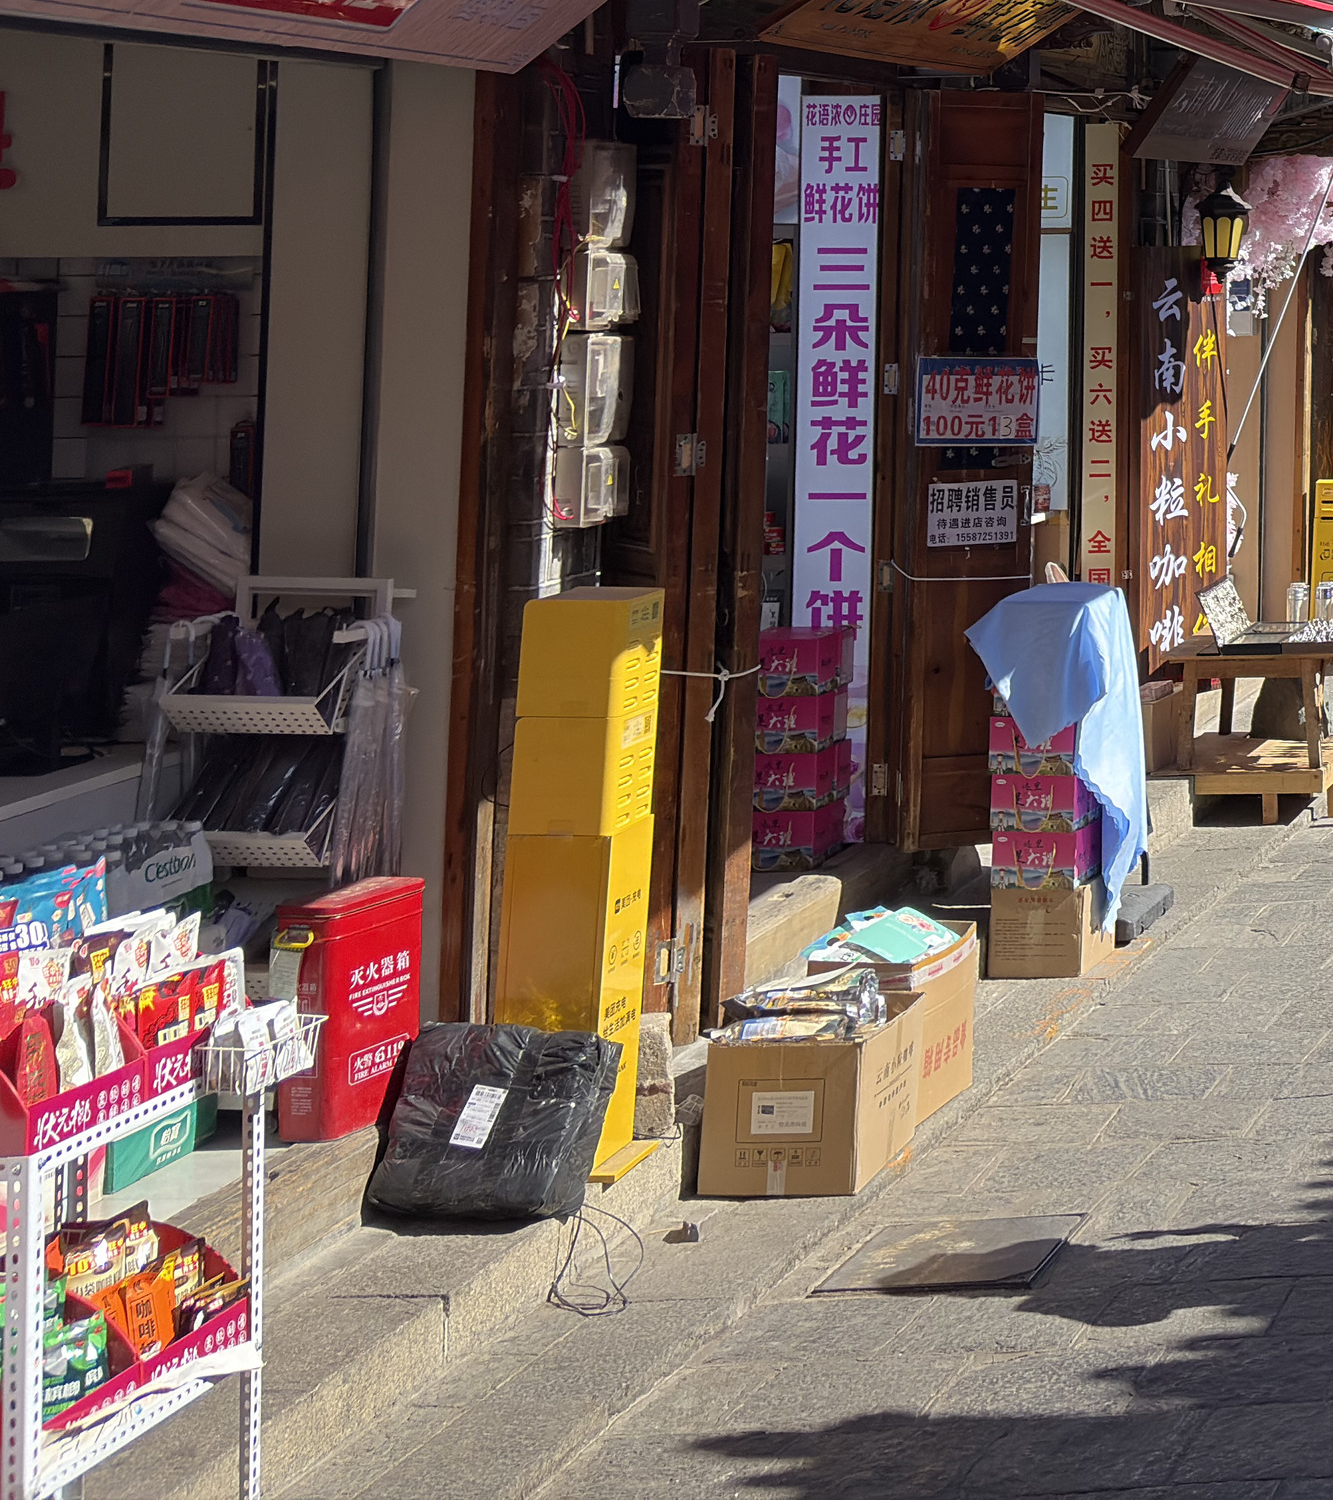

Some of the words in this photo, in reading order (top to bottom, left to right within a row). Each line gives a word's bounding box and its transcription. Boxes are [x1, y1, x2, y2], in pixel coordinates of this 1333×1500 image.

[806, 104, 842, 127] 花语浓
[858, 104, 881, 127] 庄园
[819, 135, 868, 174] 手工
[804, 183, 879, 224] 鲜花饼
[925, 366, 1036, 406] 40克鲜花饼
[923, 412, 1034, 439] 100元13盒
[1149, 277, 1189, 652] 云南小粒咖啡
[930, 485, 1016, 514] 招聘销售员
[937, 516, 1007, 530] 待遇进店咨询
[957, 531, 1014, 542] 15587251391
[350, 950, 410, 989] 灭火器箱
[348, 989, 361, 1001] FIRE
[352, 1052, 373, 1073] 火警
[353, 1067, 370, 1082] FIRE
[370, 1060, 393, 1075] ALARM
